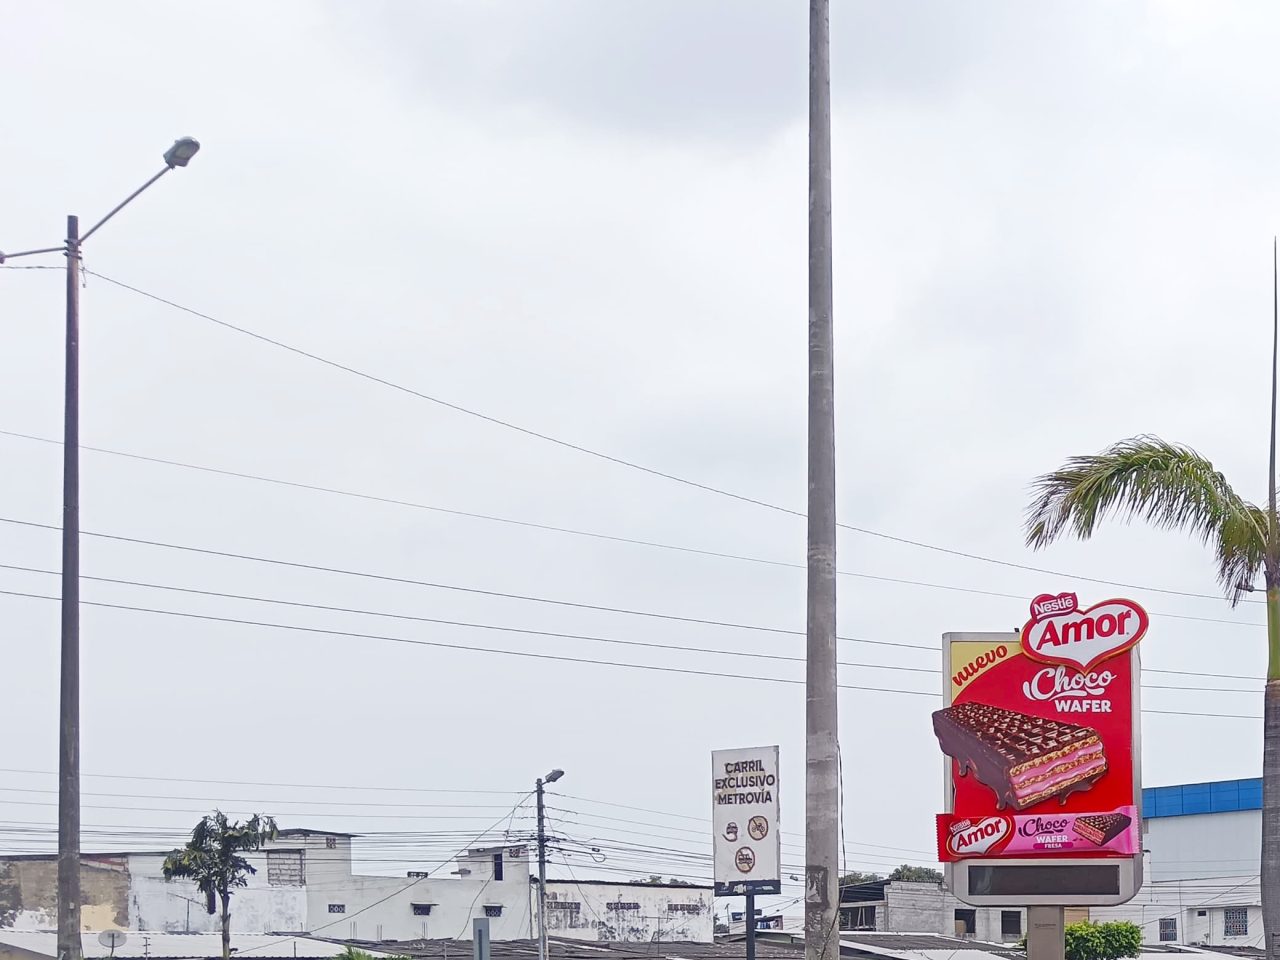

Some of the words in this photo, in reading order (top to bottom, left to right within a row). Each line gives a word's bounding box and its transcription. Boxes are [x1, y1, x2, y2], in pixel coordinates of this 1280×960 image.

[1036, 609, 1132, 651] Amor
[952, 645, 1008, 687] nuevo
[1023, 665, 1118, 701] Choco
[1055, 699, 1112, 713] WAFER
[724, 760, 765, 774] CARRIL
[715, 774, 775, 790] EXCLUSIVO
[717, 788, 773, 805] METROVÍA
[957, 819, 1001, 851] Amor
[1018, 817, 1070, 837] Choco
[1036, 835, 1068, 843] WAFER
